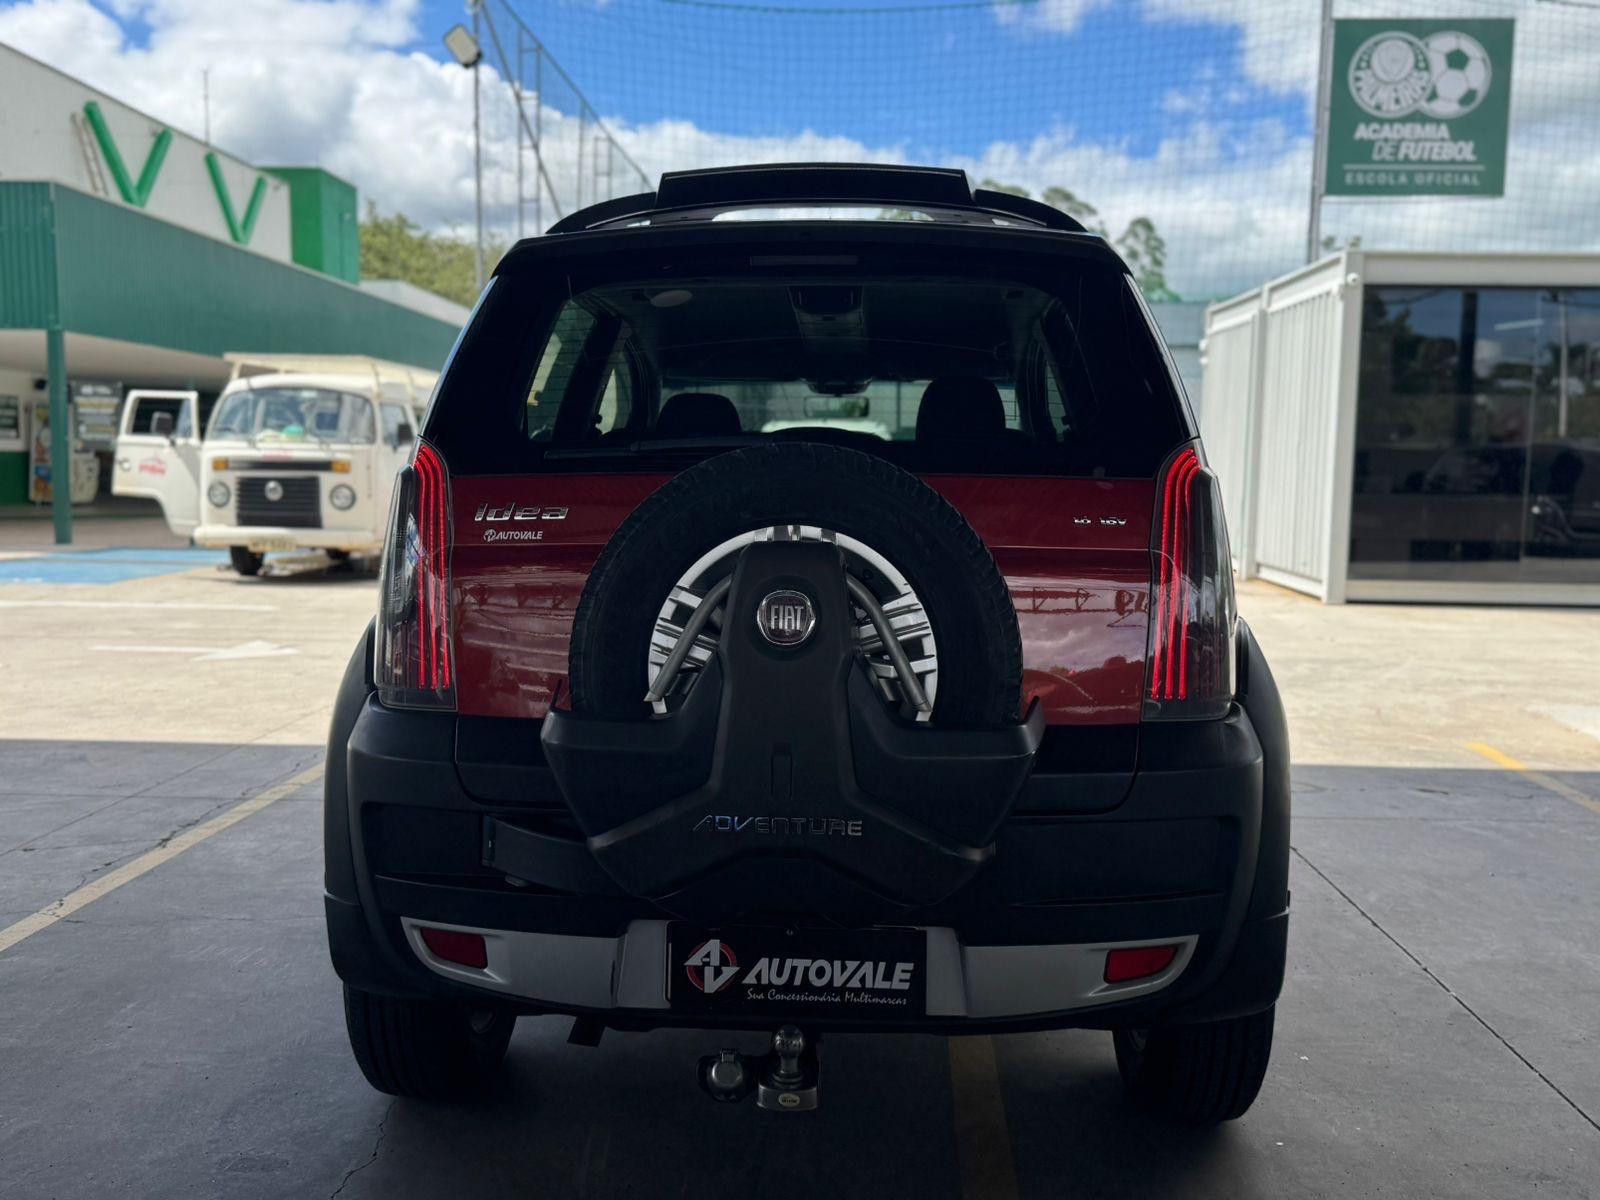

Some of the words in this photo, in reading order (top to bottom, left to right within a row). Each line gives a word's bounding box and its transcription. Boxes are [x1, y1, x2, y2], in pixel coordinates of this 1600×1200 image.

[1353, 122, 1450, 141] ACADEMIA
[1372, 141, 1398, 160] DE
[1398, 141, 1477, 161] FUTEBOL
[1345, 171, 1408, 186] ESCOLA
[1415, 171, 1480, 186] OFICIAL
[474, 502, 569, 522] Idea
[496, 531, 543, 540] AUTOVALE
[770, 605, 804, 630] FIAT
[693, 814, 863, 836] ADVENTURE
[742, 957, 914, 990] AUTOVALE
[747, 988, 765, 1000] Sua
[767, 988, 841, 1003] Concessionária
[844, 991, 907, 1006] Multimarcas
